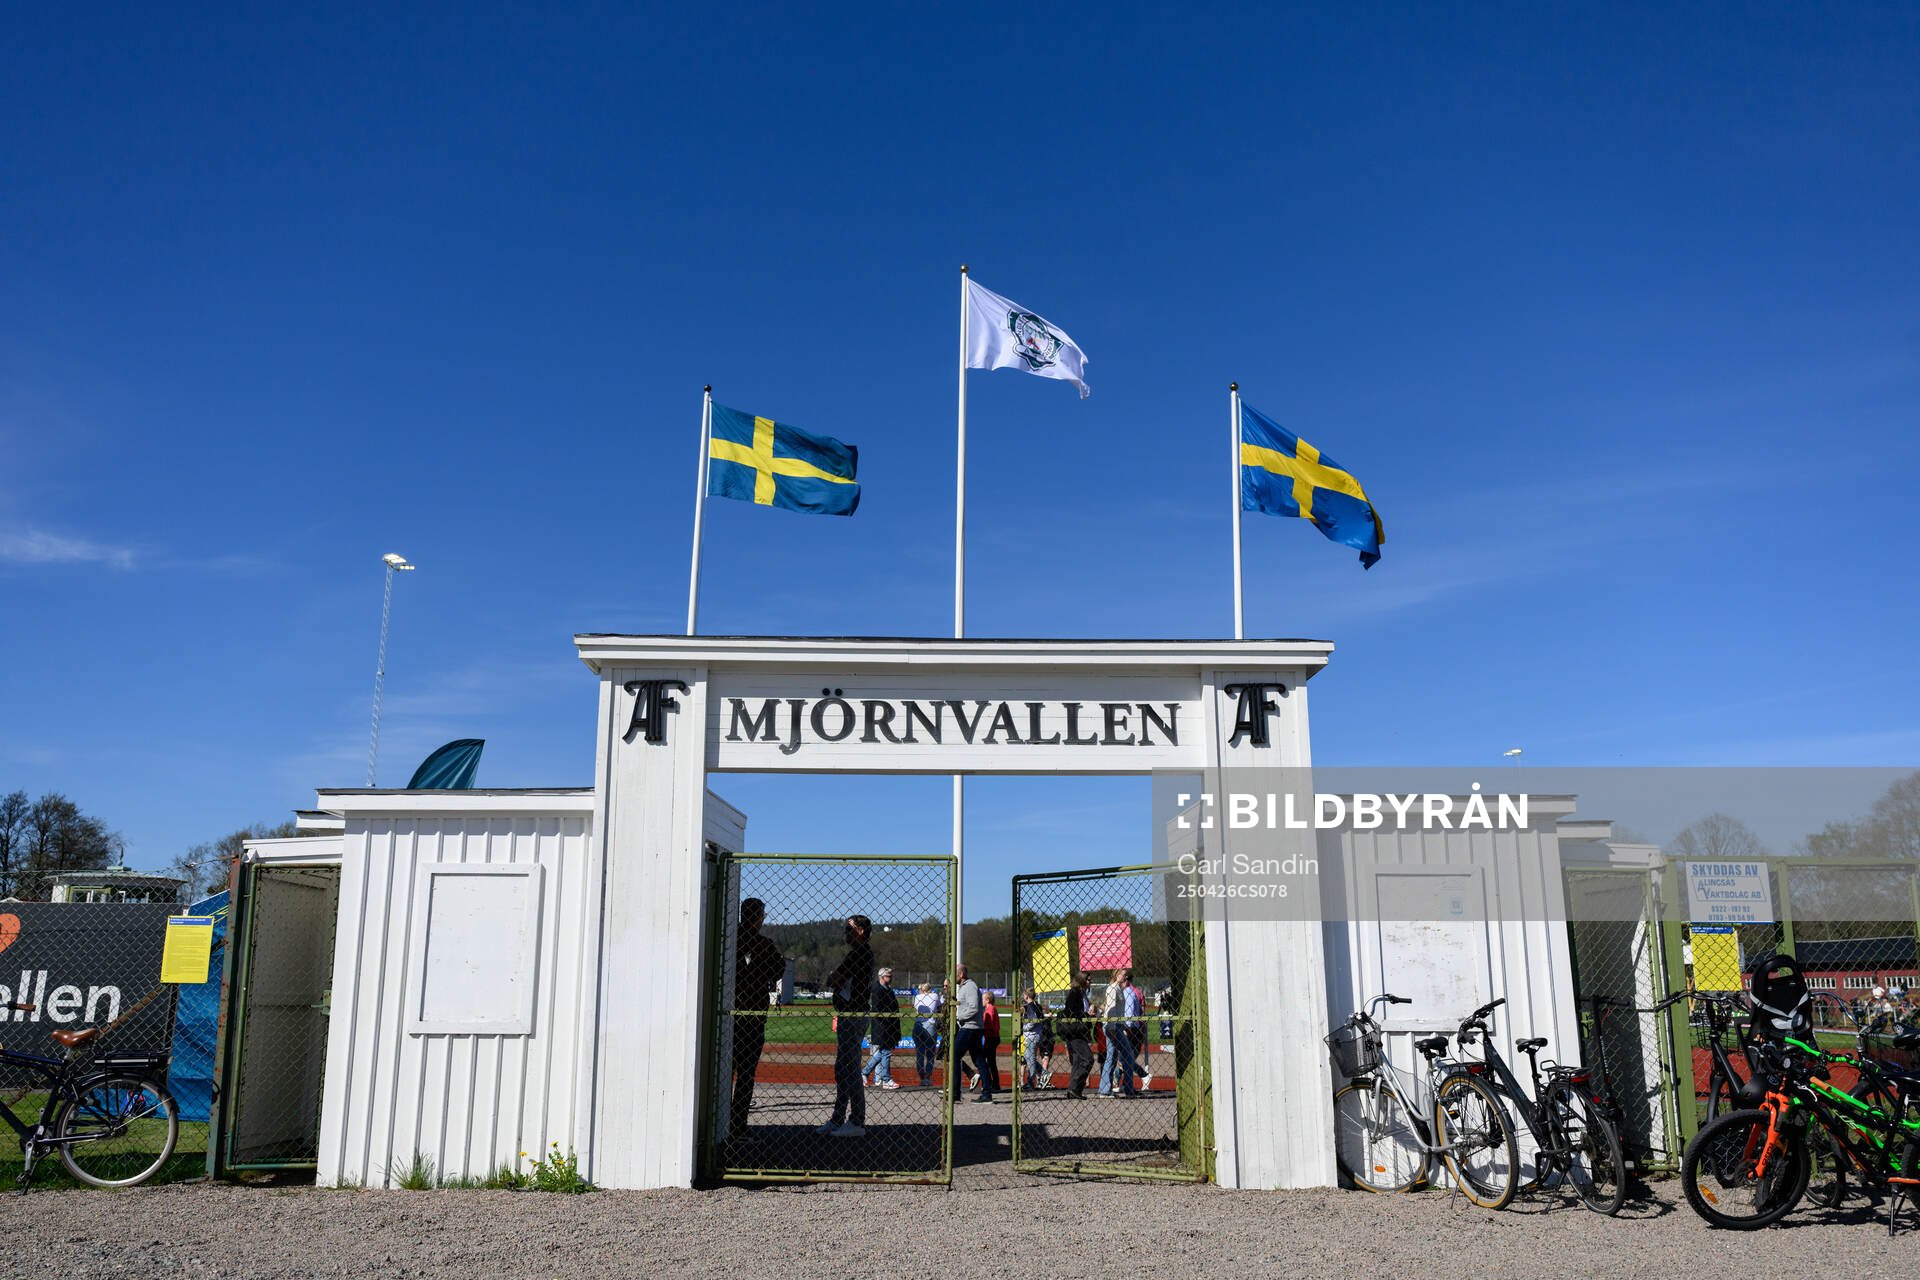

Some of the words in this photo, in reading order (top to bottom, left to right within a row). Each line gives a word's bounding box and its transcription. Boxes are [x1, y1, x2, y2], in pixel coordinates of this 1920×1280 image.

[724, 688, 1182, 755] MJÖRNVALLEN
[1692, 864, 1742, 876] SKYDDAS
[1745, 864, 1758, 876] AV
[1702, 888, 1749, 900] VAKTBOLAG
[1751, 891, 1761, 899] AB
